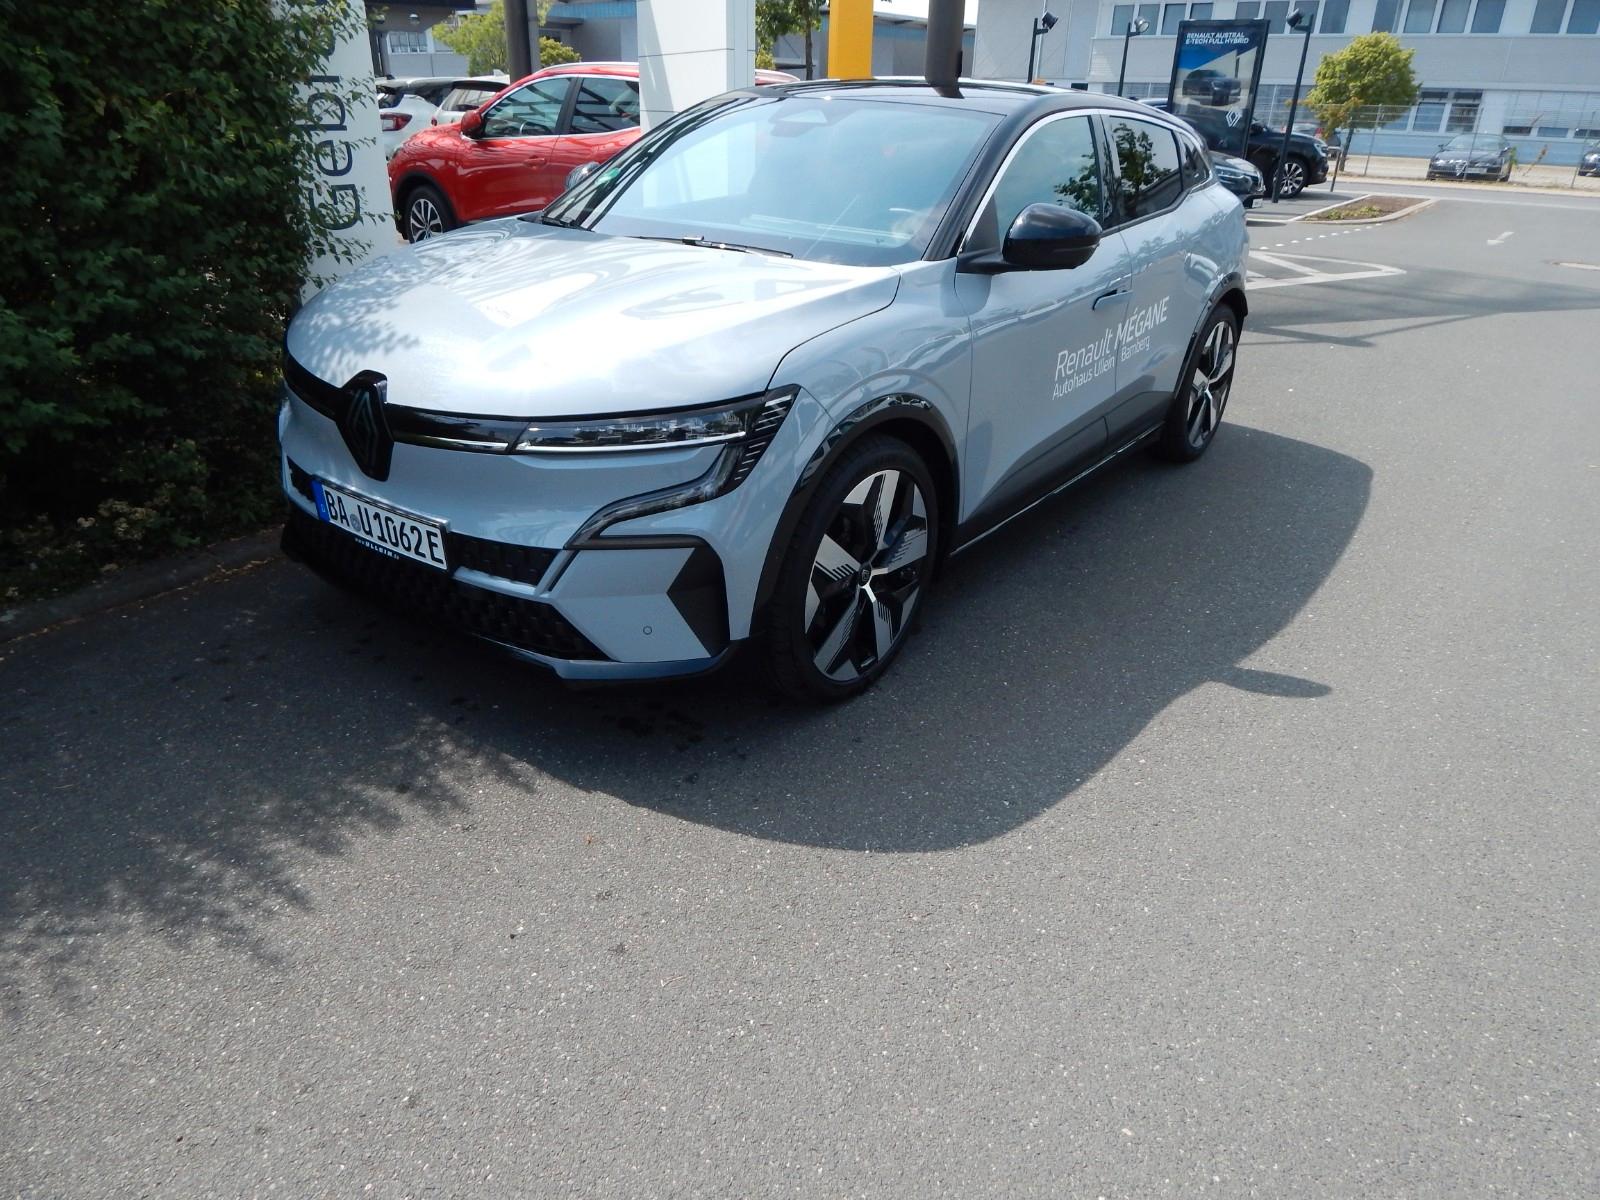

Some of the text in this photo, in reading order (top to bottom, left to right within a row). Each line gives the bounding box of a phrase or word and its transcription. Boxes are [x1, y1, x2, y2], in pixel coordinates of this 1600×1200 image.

[1052, 336, 1150, 401] Autohaus Ullein Bamberg
[1055, 296, 1170, 381] Renault MÉGANE
[325, 489, 350, 527] BA
